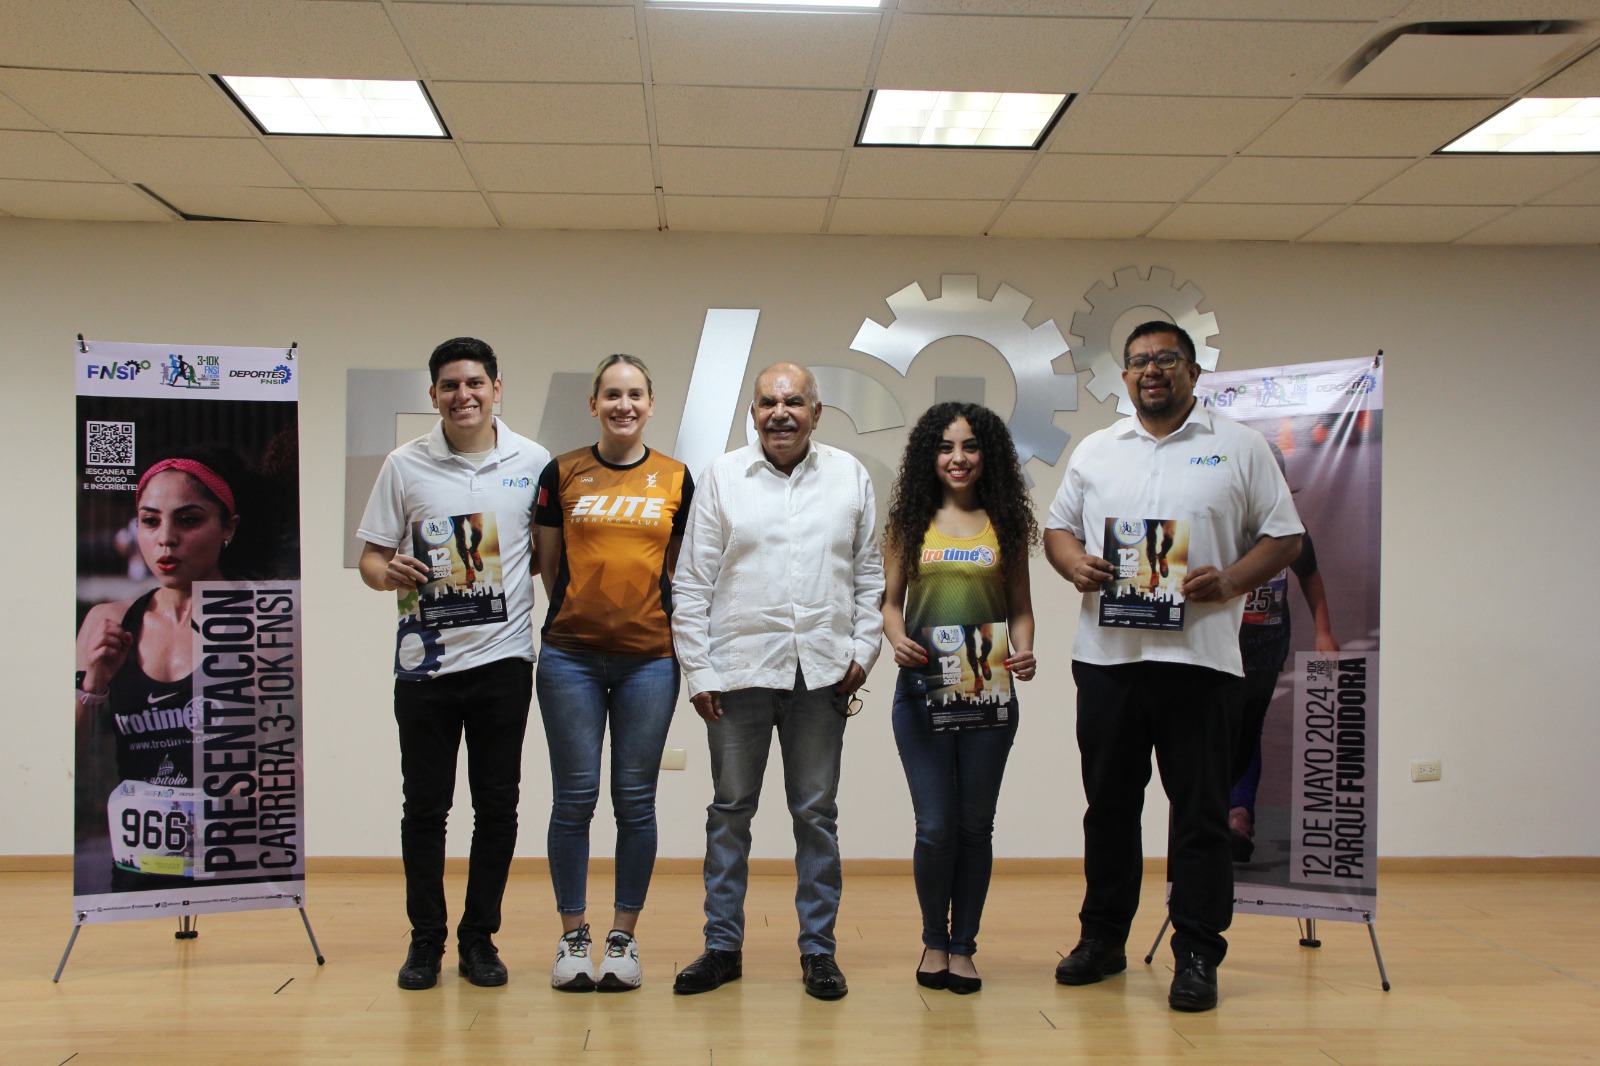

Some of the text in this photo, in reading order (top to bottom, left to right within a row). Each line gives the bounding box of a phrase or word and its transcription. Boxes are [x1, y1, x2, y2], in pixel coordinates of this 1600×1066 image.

[197, 355, 220, 366] 3-10K
[87, 362, 135, 381] FNSI
[204, 366, 220, 375] FNSI
[229, 370, 286, 379] DEPORTES
[85, 467, 137, 476] ¡ESCANEA EL
[1189, 457, 1217, 467] FNSI
[83, 482, 139, 491] E INSCRÍBETE!
[94, 475, 128, 483] CÓDIGO
[502, 478, 528, 489] FNSI
[570, 495, 666, 519] ELITE
[629, 518, 659, 526] CLUB
[428, 547, 452, 567] 12
[921, 546, 980, 565] trotime
[1117, 547, 1140, 566] 12
[433, 565, 453, 573] MAYO
[433, 571, 453, 579] 2024
[1119, 565, 1139, 573] MAYO
[1119, 571, 1138, 579] 2024
[255, 588, 294, 649] FNSI
[938, 655, 962, 674] 12
[1306, 660, 1318, 682] 3-10K
[1317, 660, 1326, 676] FNSI
[943, 678, 962, 686] 2024
[256, 652, 296, 732] 3-10K
[1305, 686, 1336, 744] 2024
[191, 589, 257, 873] PRESENTACIÓN
[1335, 657, 1367, 793] FUNDIDORA
[1303, 747, 1334, 813] MAYO
[257, 739, 298, 870] CARRERA
[121, 808, 188, 851] 966
[1303, 817, 1333, 849] DE
[1334, 796, 1367, 880] PARQUE
[1302, 853, 1332, 878] 12
